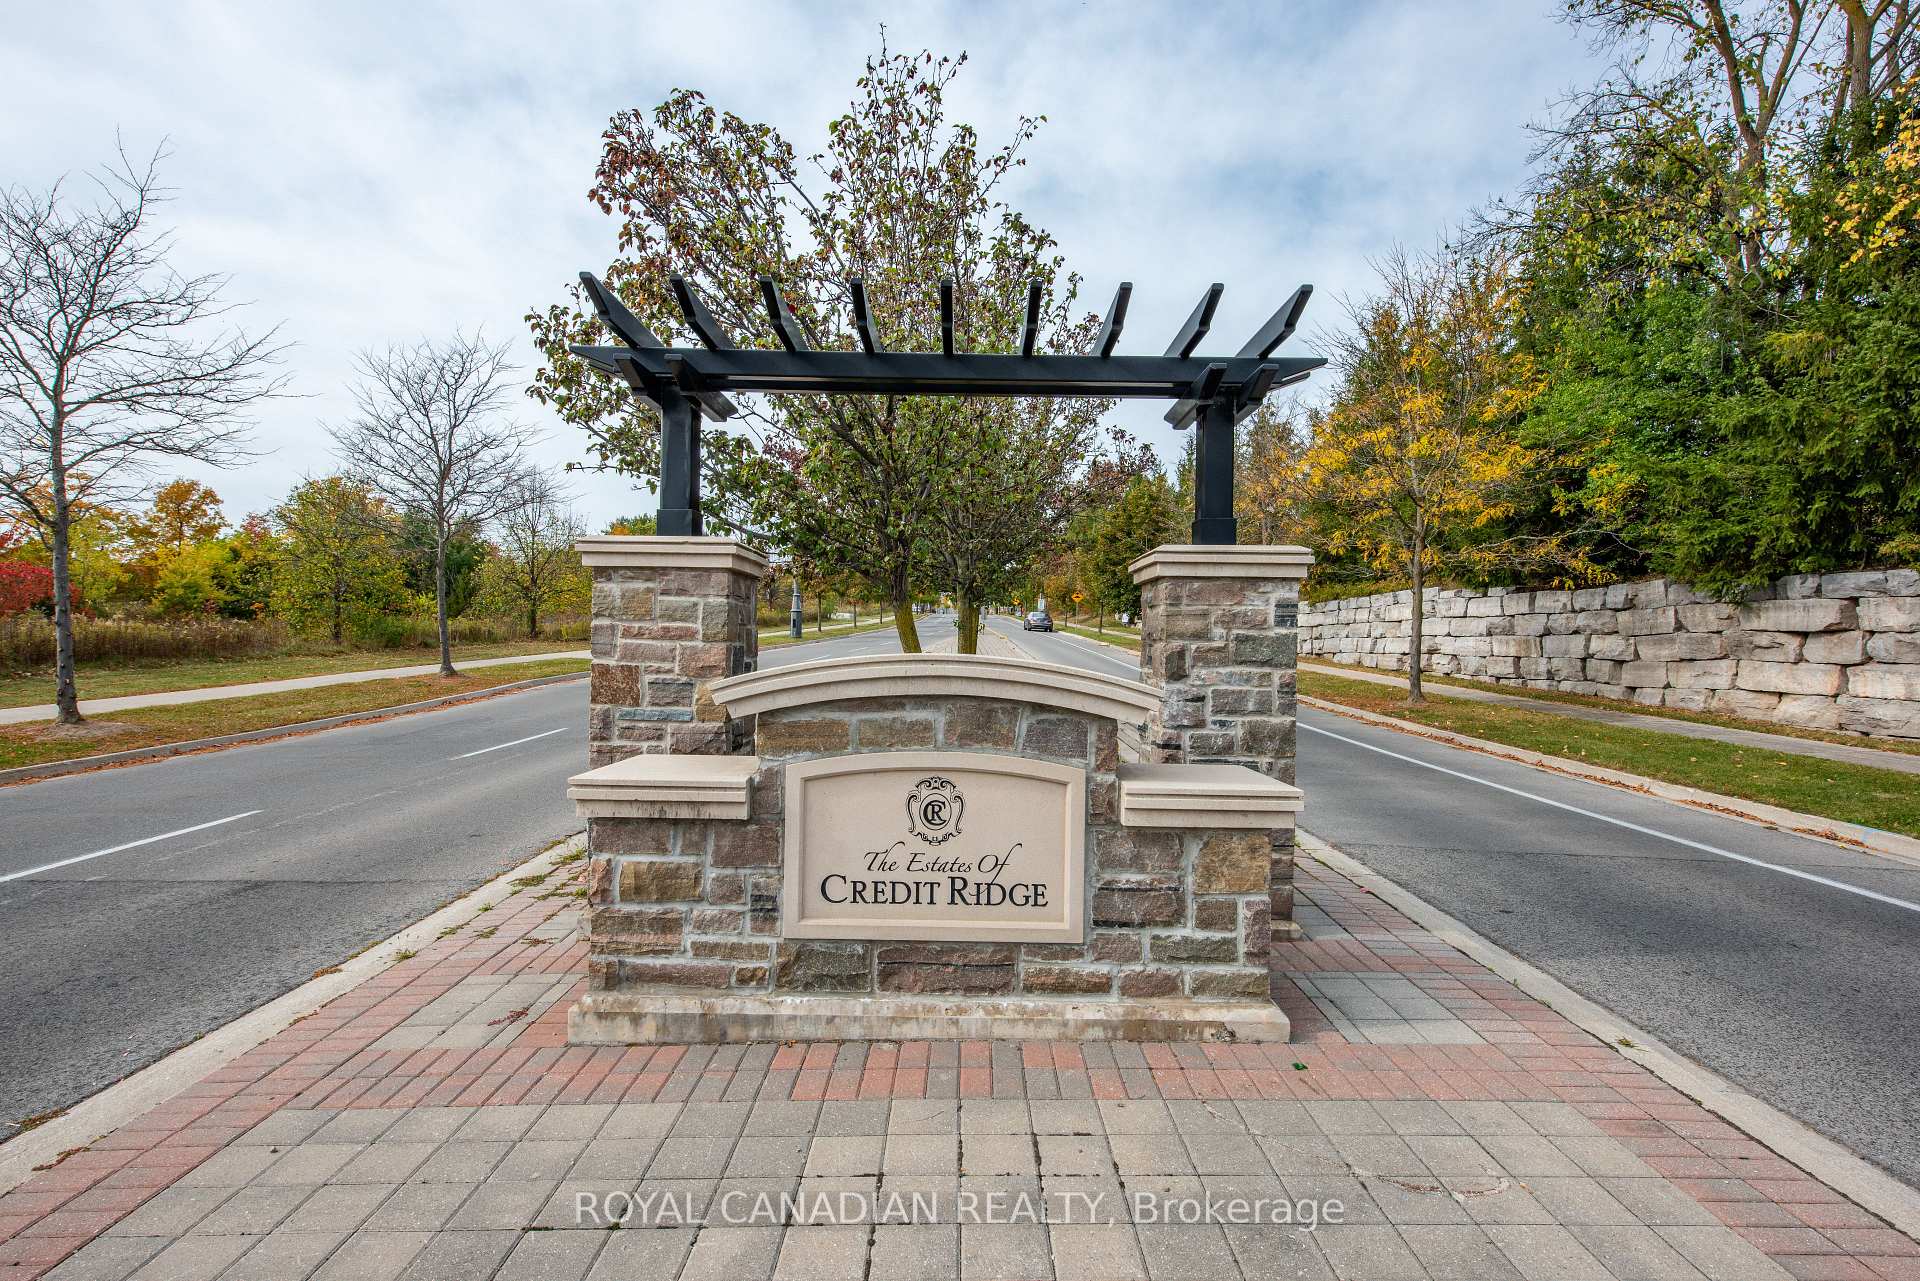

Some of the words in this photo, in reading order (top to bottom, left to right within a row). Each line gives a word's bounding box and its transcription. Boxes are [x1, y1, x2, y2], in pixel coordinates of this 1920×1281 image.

[820, 873, 940, 906] CREDIT
[948, 875, 1049, 908] RIDGE
[863, 841, 905, 873] The
[906, 851, 972, 874] Estates
[969, 842, 1023, 896] Of
